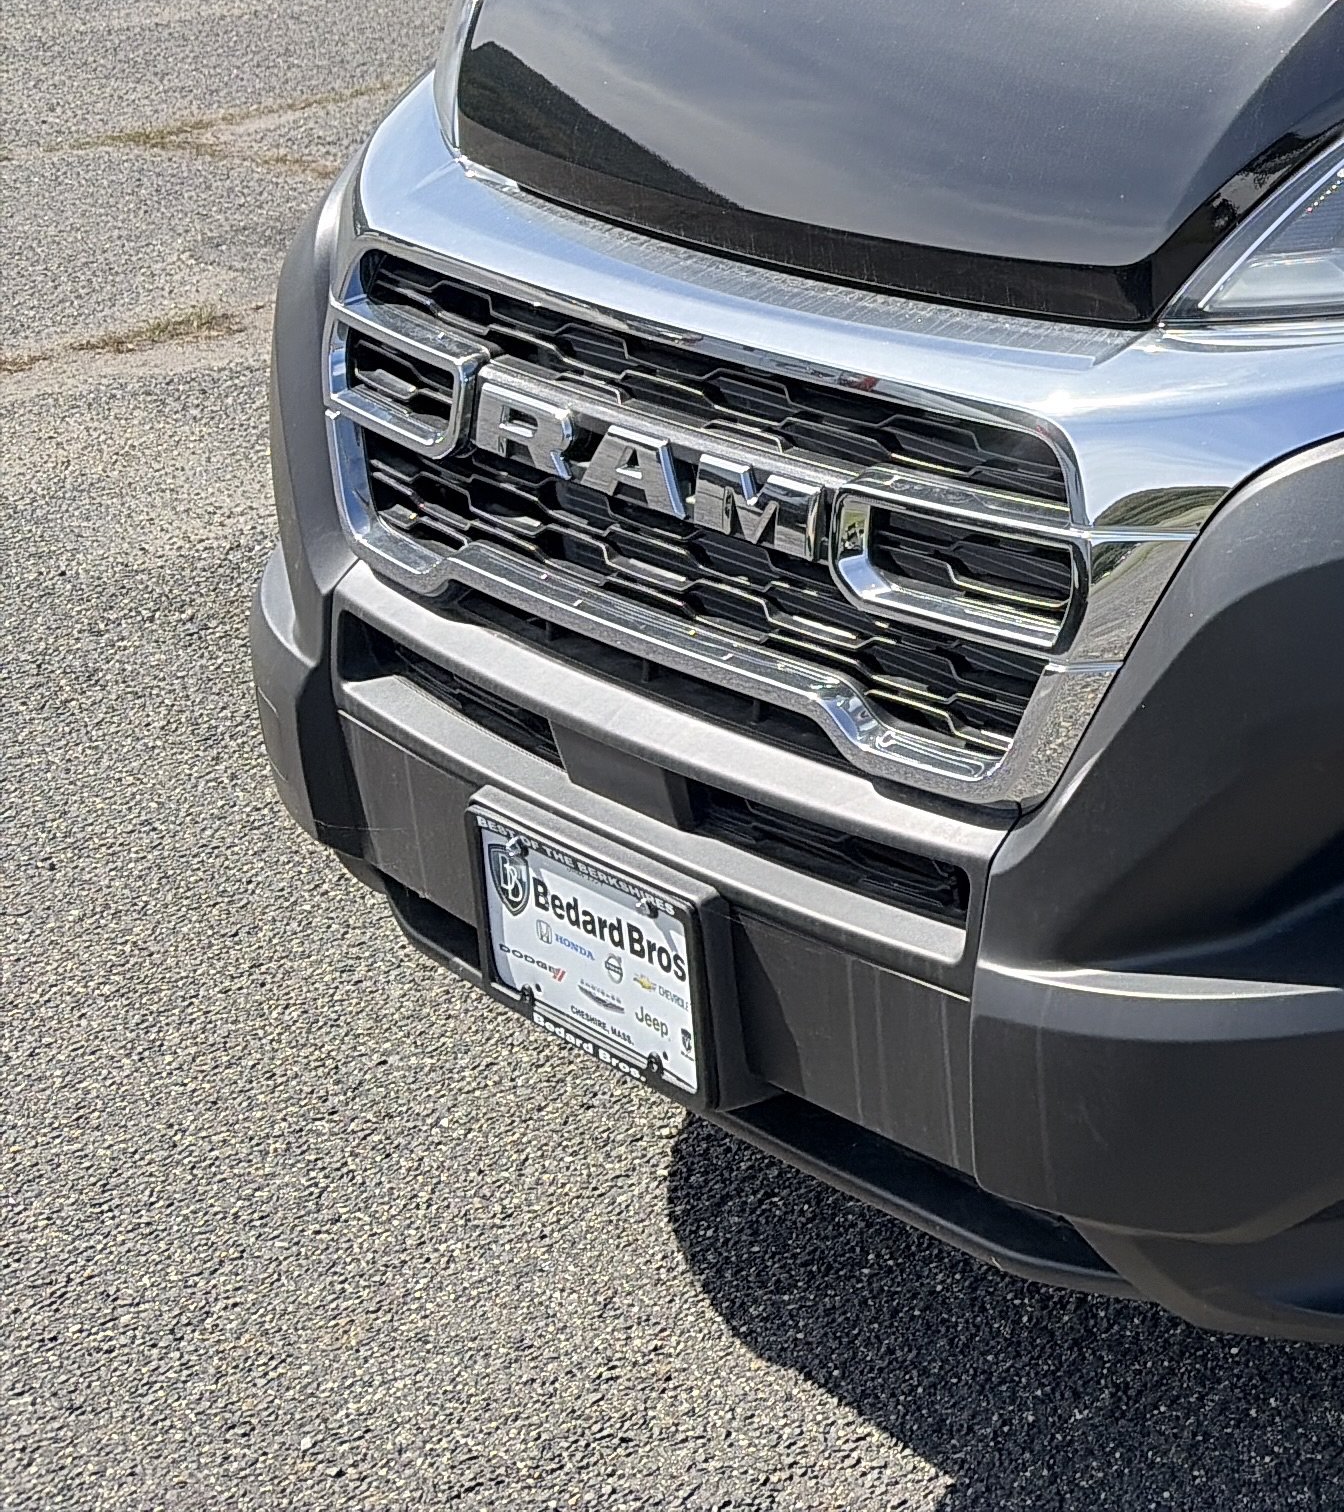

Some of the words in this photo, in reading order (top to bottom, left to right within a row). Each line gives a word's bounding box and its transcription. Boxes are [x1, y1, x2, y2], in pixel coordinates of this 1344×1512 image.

[473, 382, 822, 561] RAM
[477, 816, 516, 839] BEST
[519, 835, 539, 850] OF
[542, 845, 575, 868] THE
[576, 862, 676, 916] BERKSHIRES
[532, 876, 626, 951] Bedard
[626, 922, 687, 982] Bros
[555, 933, 596, 961] HONDA
[532, 1011, 594, 1055] Bedard
[598, 1048, 647, 1082] Bros.
[635, 1005, 669, 1038] Jeep
